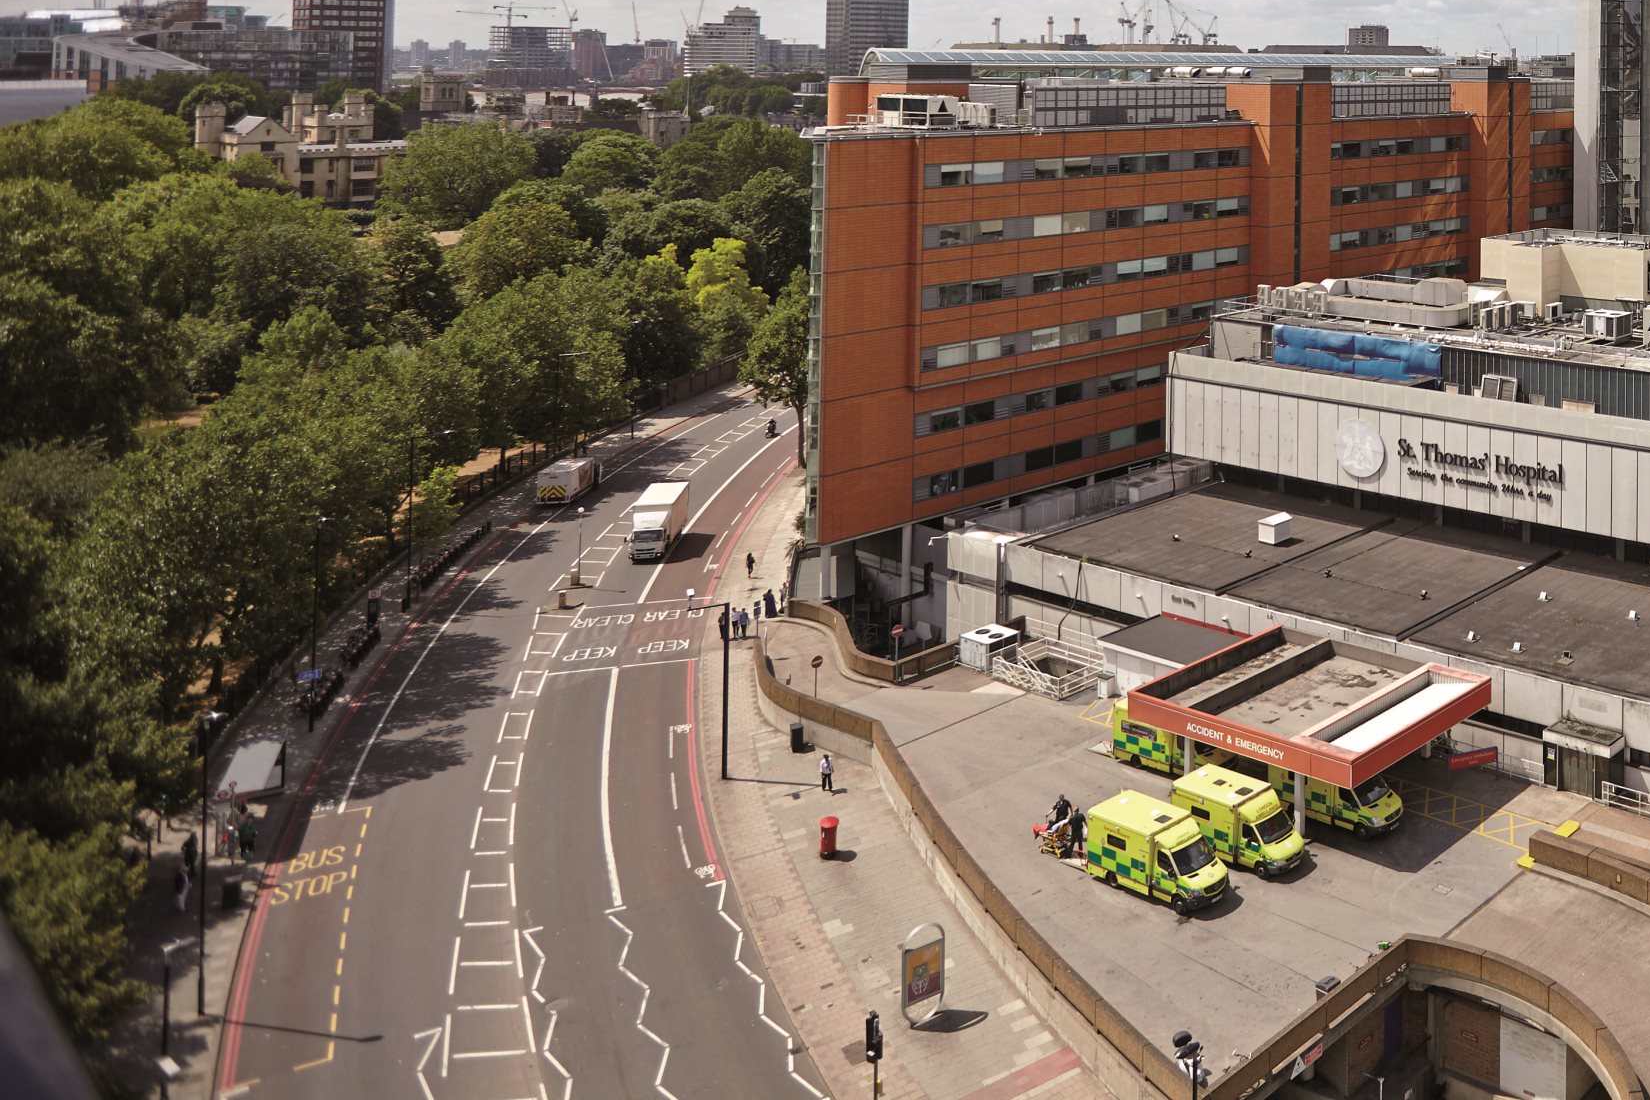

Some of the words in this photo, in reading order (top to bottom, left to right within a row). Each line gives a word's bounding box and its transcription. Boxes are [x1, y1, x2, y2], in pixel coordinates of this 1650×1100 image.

[1407, 467, 1436, 482] Serving
[1440, 473, 1454, 483] the
[1455, 477, 1498, 492] community
[1537, 490, 1552, 502] day
[1494, 454, 1563, 486] Hospital
[573, 612, 635, 629] CLEAR
[563, 645, 618, 662] KEEP
[638, 638, 690, 654] KEEP
[1186, 722, 1224, 742] ACCIDENT
[1226, 734, 1232, 745] &
[1235, 738, 1285, 760] EMERGENCY
[288, 845, 346, 874] BUS
[271, 871, 348, 905] STOP
